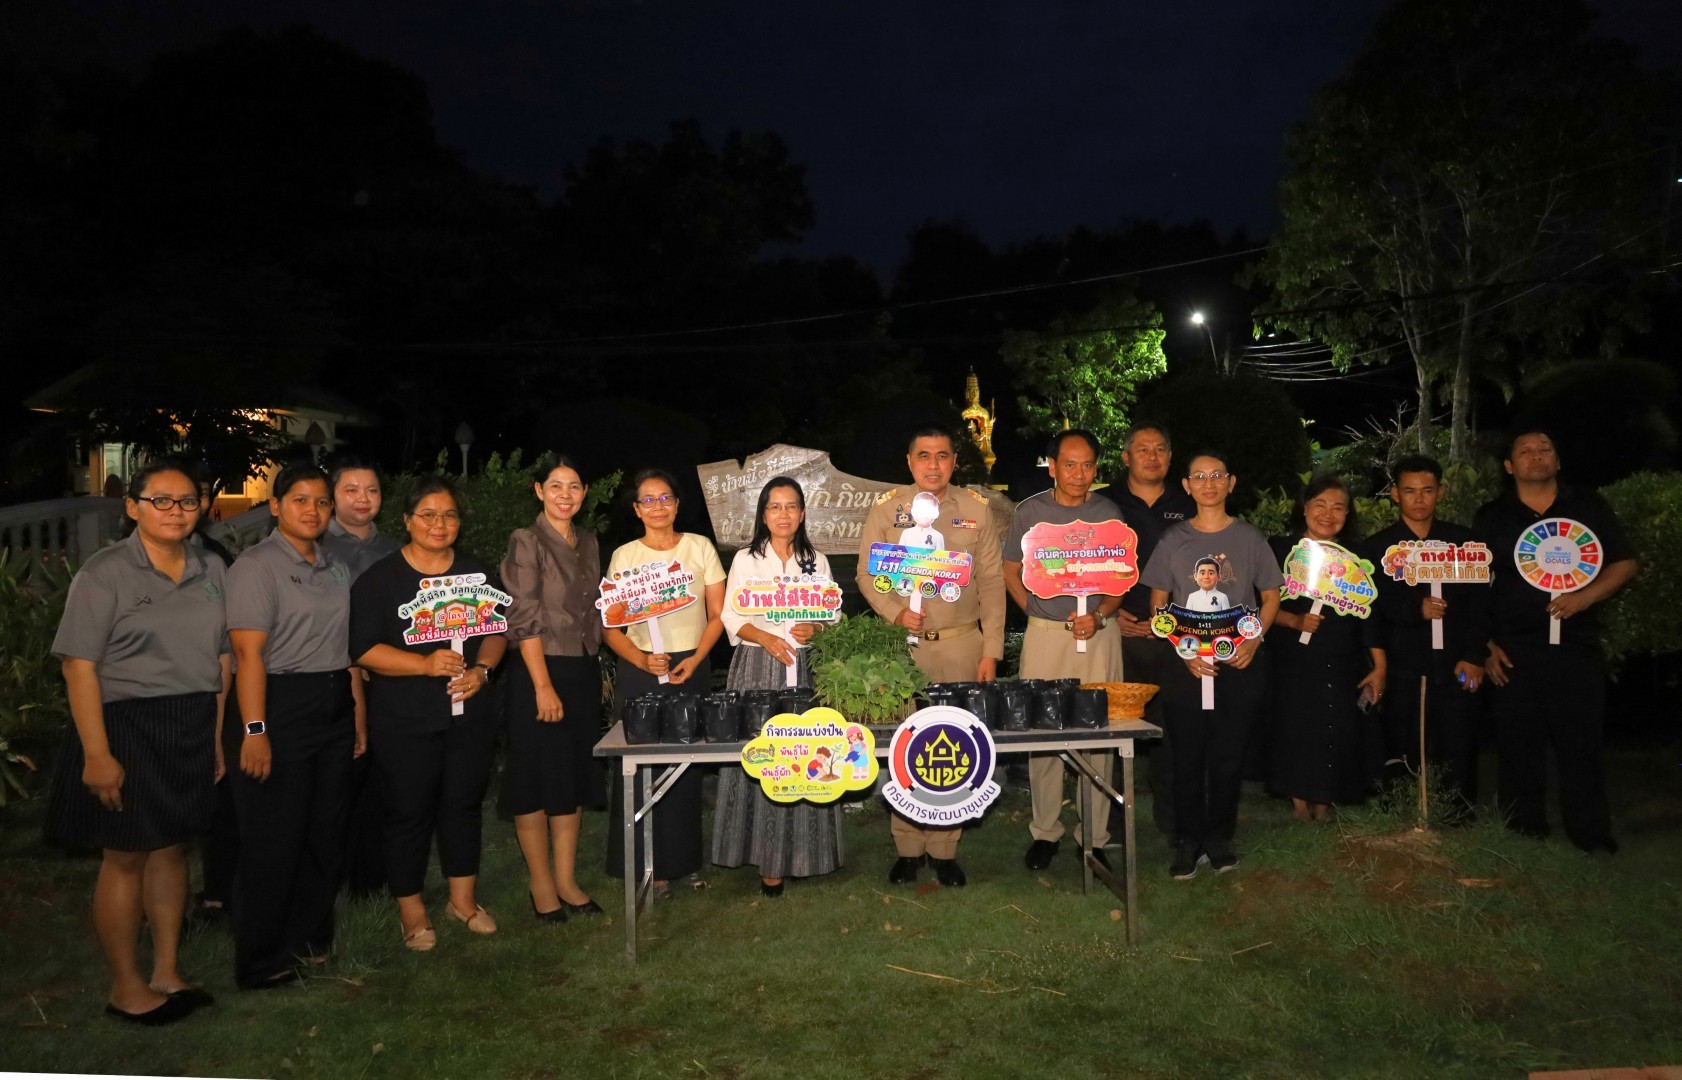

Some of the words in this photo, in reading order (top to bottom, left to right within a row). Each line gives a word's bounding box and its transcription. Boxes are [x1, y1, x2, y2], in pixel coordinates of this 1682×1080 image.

[721, 460, 757, 493] บ้านนี้
[1420, 544, 1486, 562] ทางนี้มีผล
[876, 560, 900, 573] 1+11
[899, 566, 933, 576] AGENDA
[934, 570, 961, 580] KORAT
[1403, 562, 1489, 584] ผู้คนรักกัน
[604, 588, 647, 606] ทางนี้มีผล
[650, 573, 694, 595] ผู้คนรักกัน
[738, 583, 821, 607] บ้านนี้มีรัก
[1334, 578, 1374, 597] ปลูกผัก
[400, 590, 446, 617] บ้านนี้มีรัก
[451, 585, 511, 604] ปลูกผักกินเอง
[766, 608, 833, 623] ปลูกผักกินเอง
[406, 626, 454, 643] ทางนี้มีผล
[458, 621, 506, 640] ผู้คนรักกัน
[1177, 625, 1207, 635] AGENDA
[1210, 625, 1235, 635] KORAT
[766, 723, 844, 737] กิจกรรมแบ่งปัน
[780, 744, 809, 760] พันธุ์ไม้
[887, 785, 996, 820] กรมการพัฒนาชุมชน
